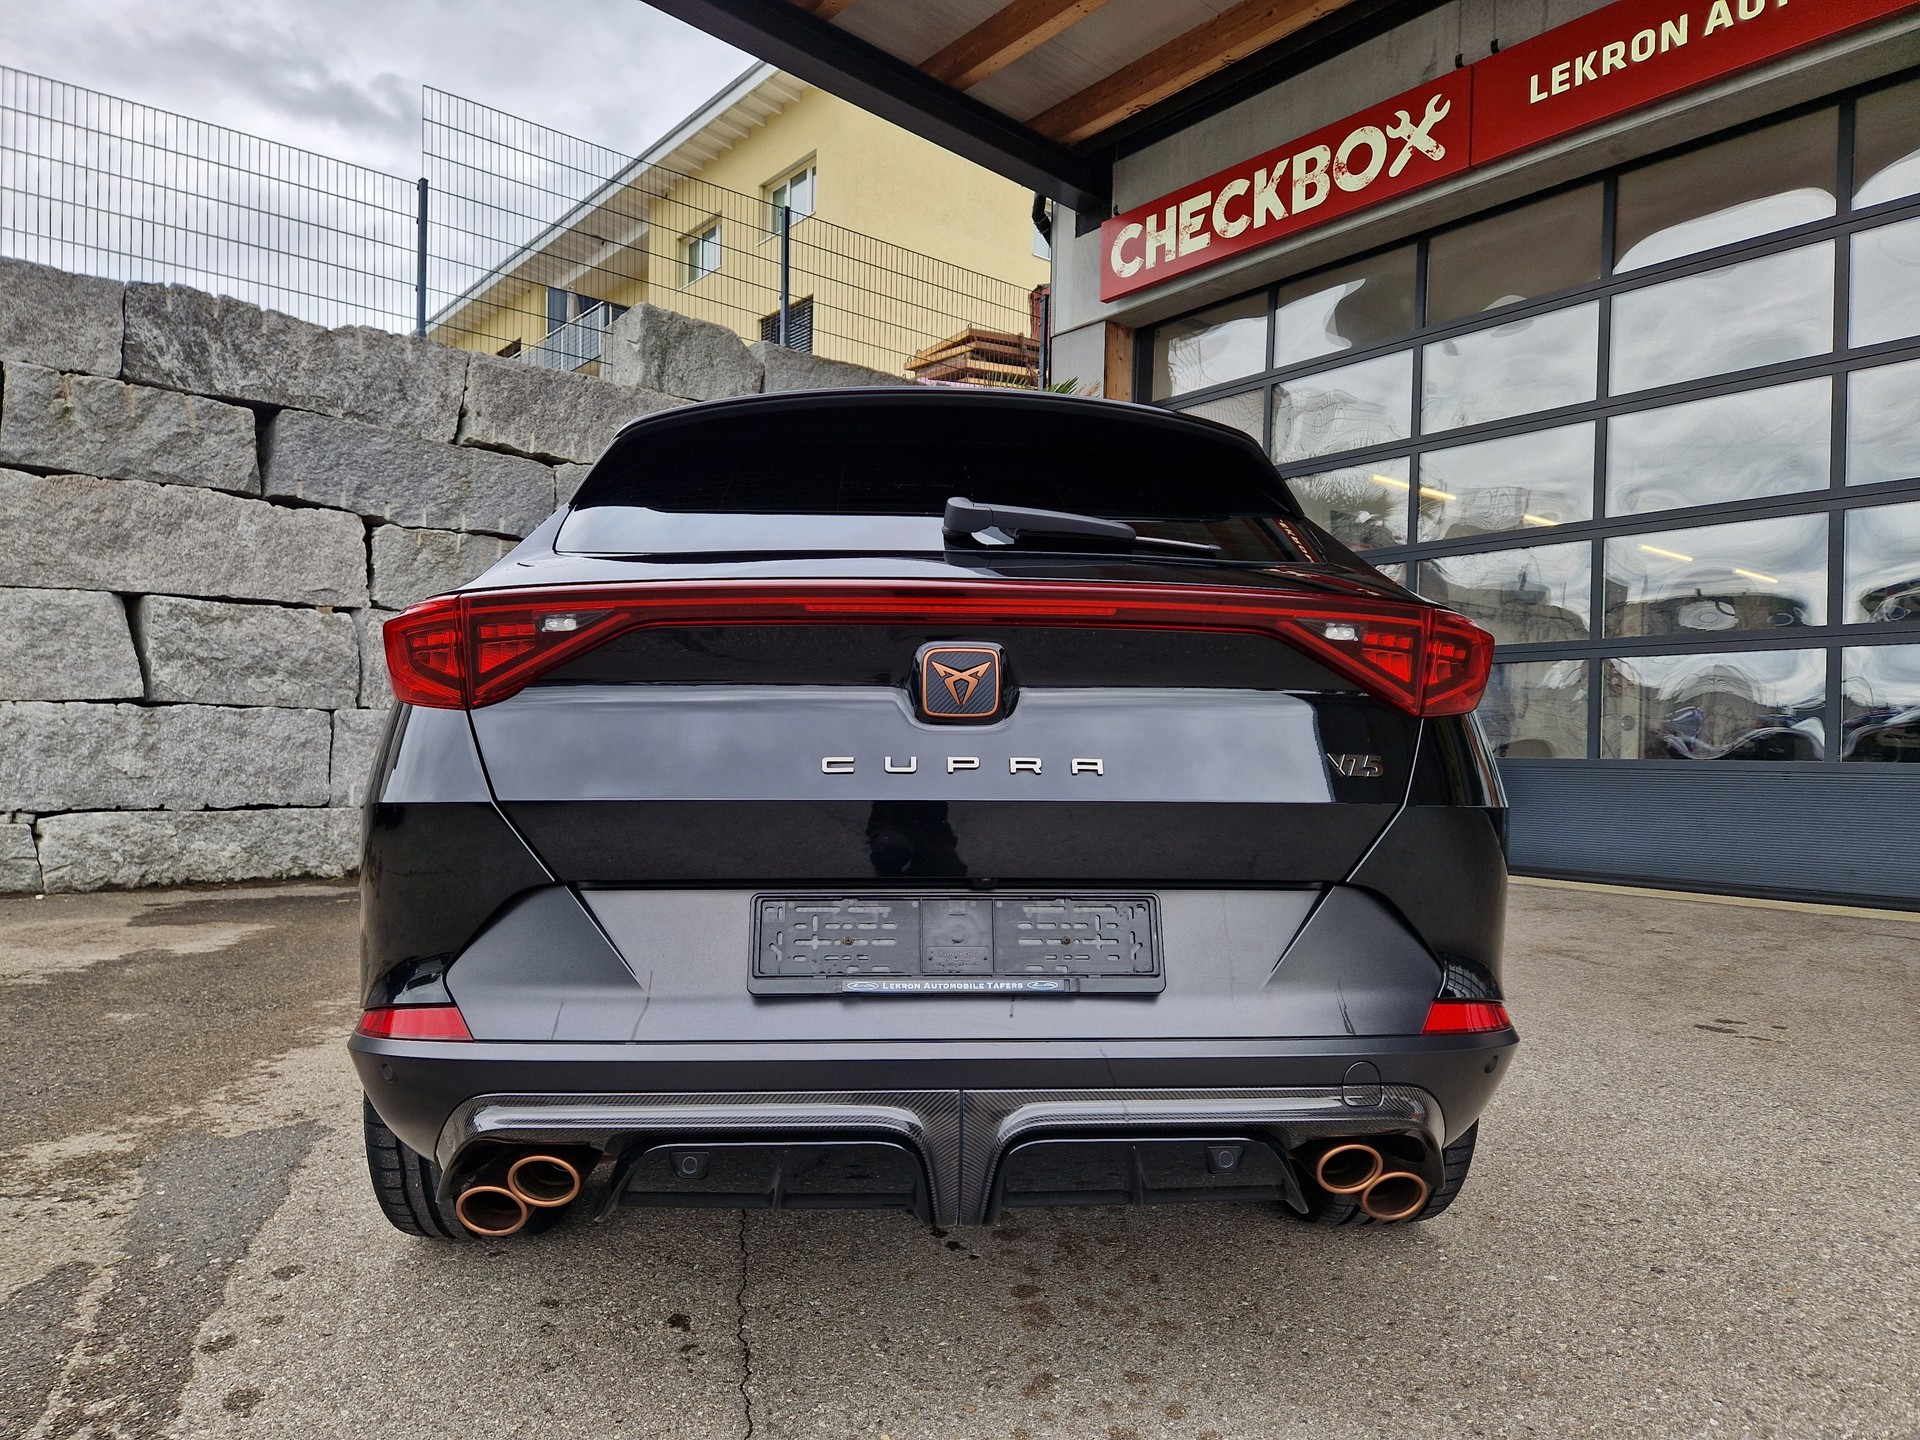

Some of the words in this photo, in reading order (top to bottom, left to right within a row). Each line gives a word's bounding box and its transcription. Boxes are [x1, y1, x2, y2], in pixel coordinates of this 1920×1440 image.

[1530, 13, 1689, 104] LEKRON
[1704, 0, 1788, 37] AU
[1110, 93, 1451, 278] CHECKBOX
[821, 756, 1105, 775] CUPRA
[882, 982, 921, 990] LEKRON
[923, 982, 985, 990] AUTOMOBILE
[986, 982, 1024, 990] TAFERS
